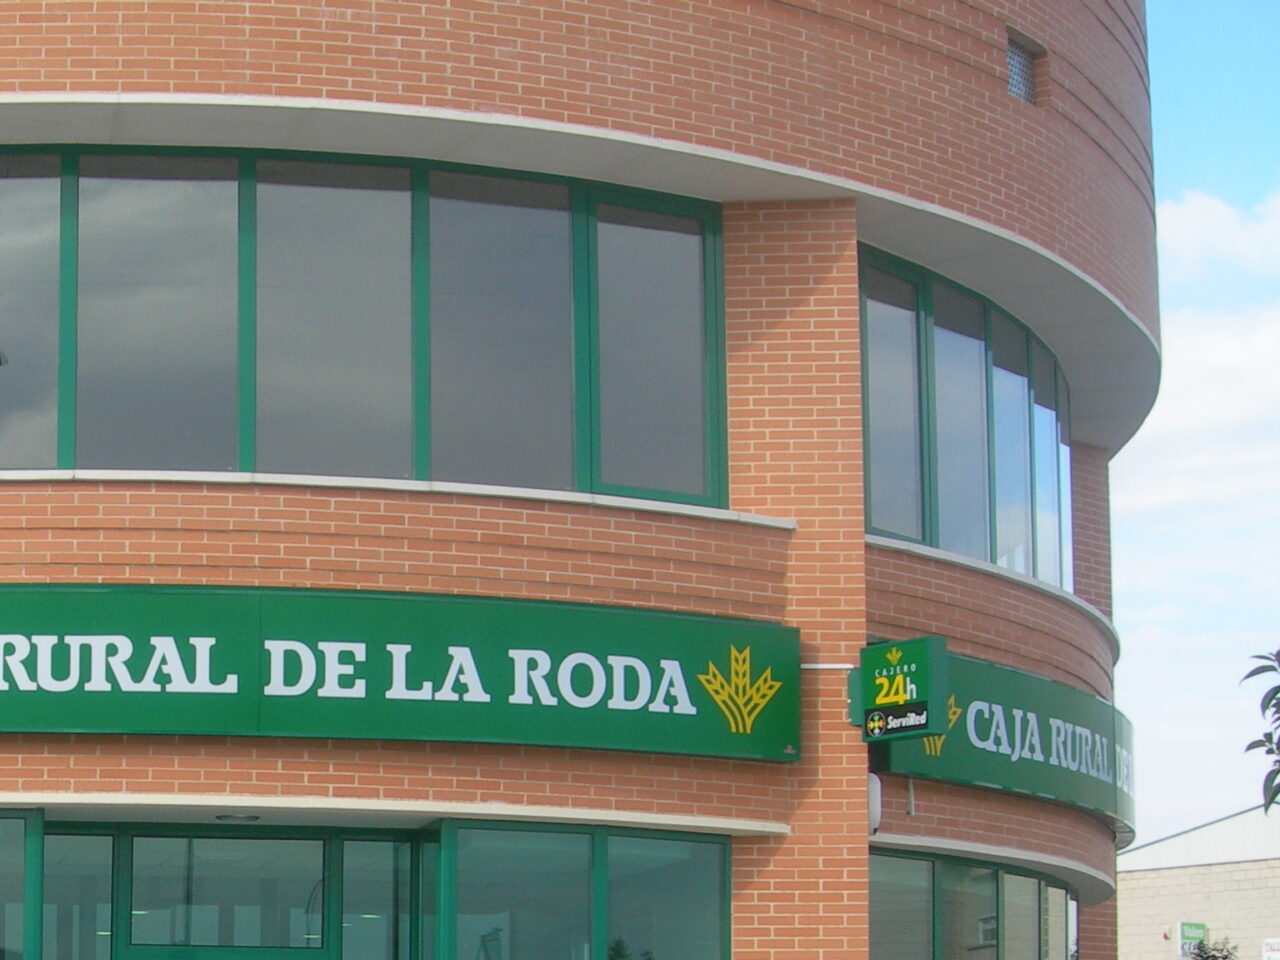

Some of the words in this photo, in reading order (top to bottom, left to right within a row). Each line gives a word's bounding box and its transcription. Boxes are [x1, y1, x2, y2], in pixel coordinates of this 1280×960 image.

[263, 639, 366, 698] DE
[385, 643, 491, 702] LA
[508, 649, 697, 715] RODA
[874, 663, 917, 678] CAJERO
[875, 673, 917, 705] 24h
[886, 710, 927, 730] ServiRed
[966, 700, 1044, 762] CAJA
[1048, 717, 1113, 784] RURAL
